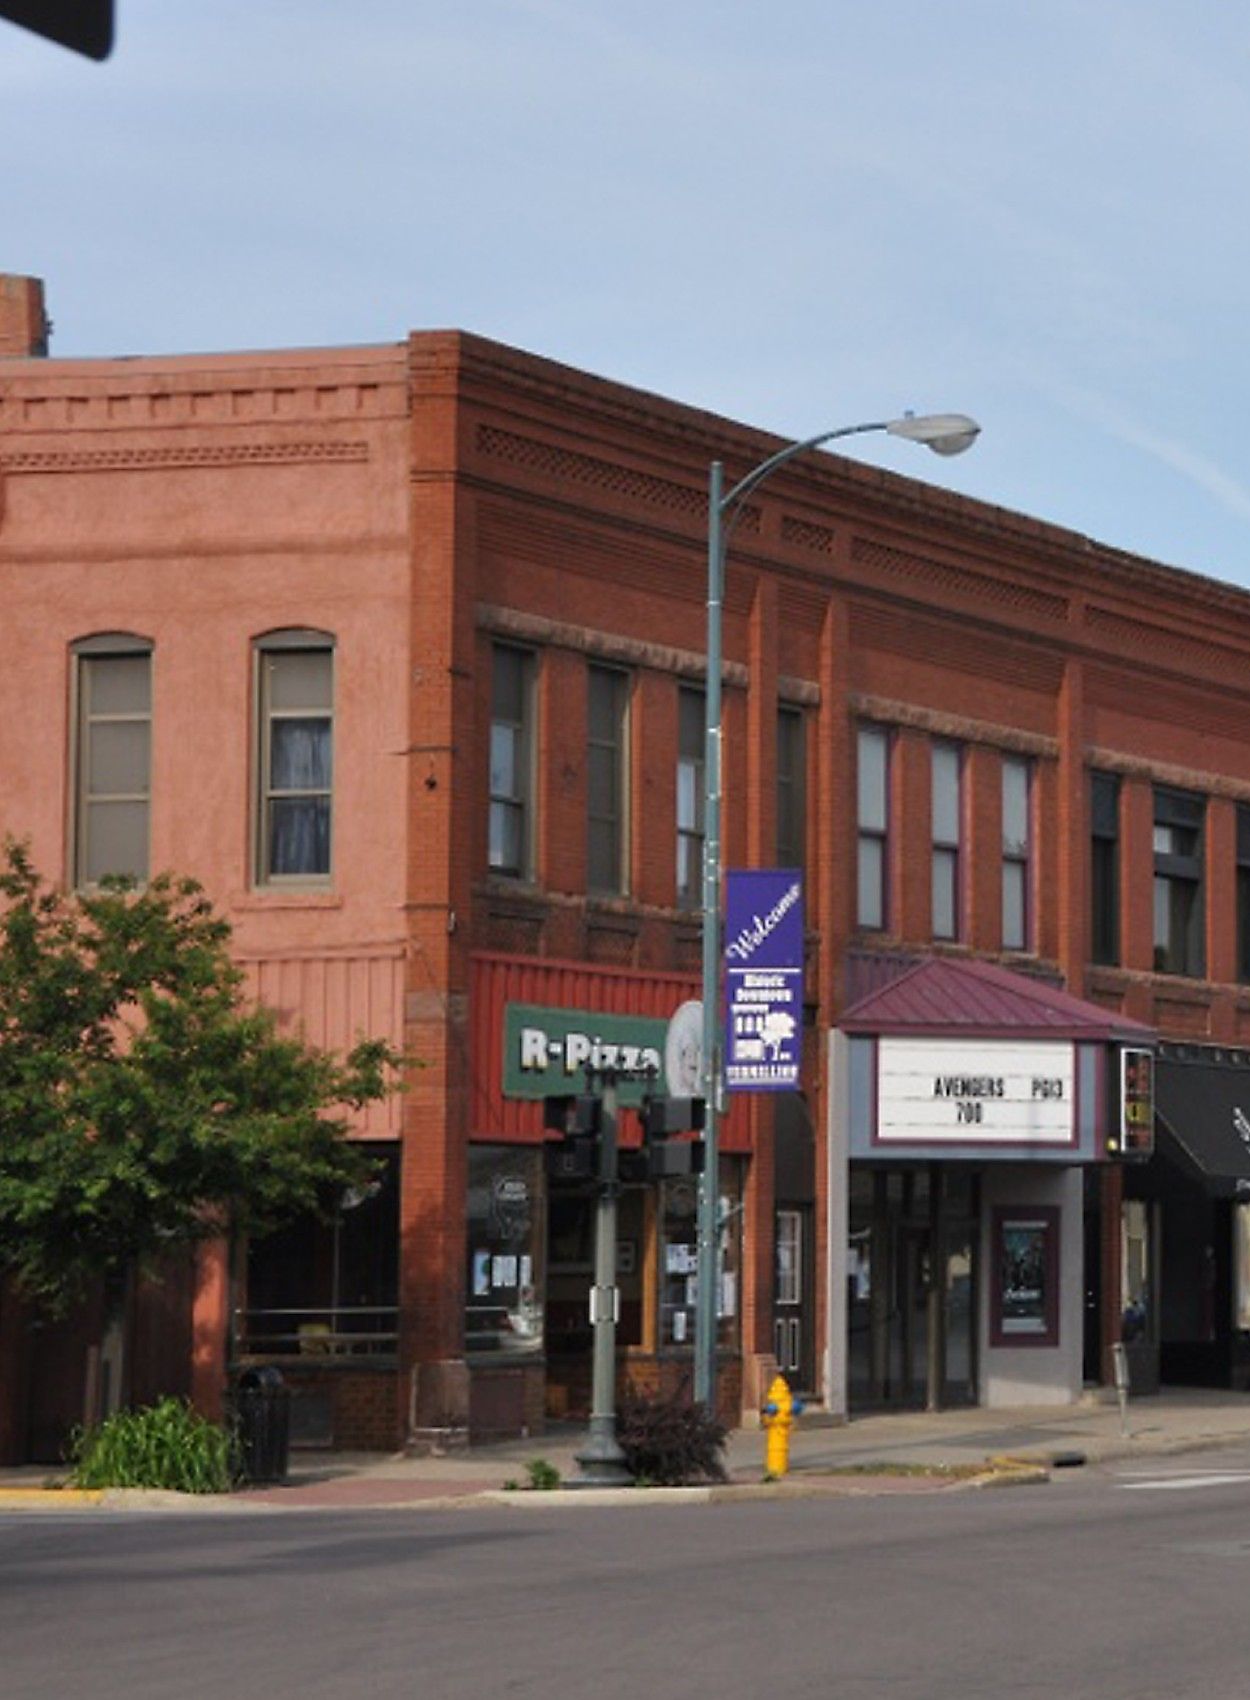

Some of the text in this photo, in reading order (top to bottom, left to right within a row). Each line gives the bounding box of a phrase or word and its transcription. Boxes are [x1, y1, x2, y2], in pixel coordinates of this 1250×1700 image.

[726, 883, 800, 959] Welcome
[520, 1027, 661, 1079] R-Pizza
[933, 1076, 1063, 1099] AVENGERS PG13
